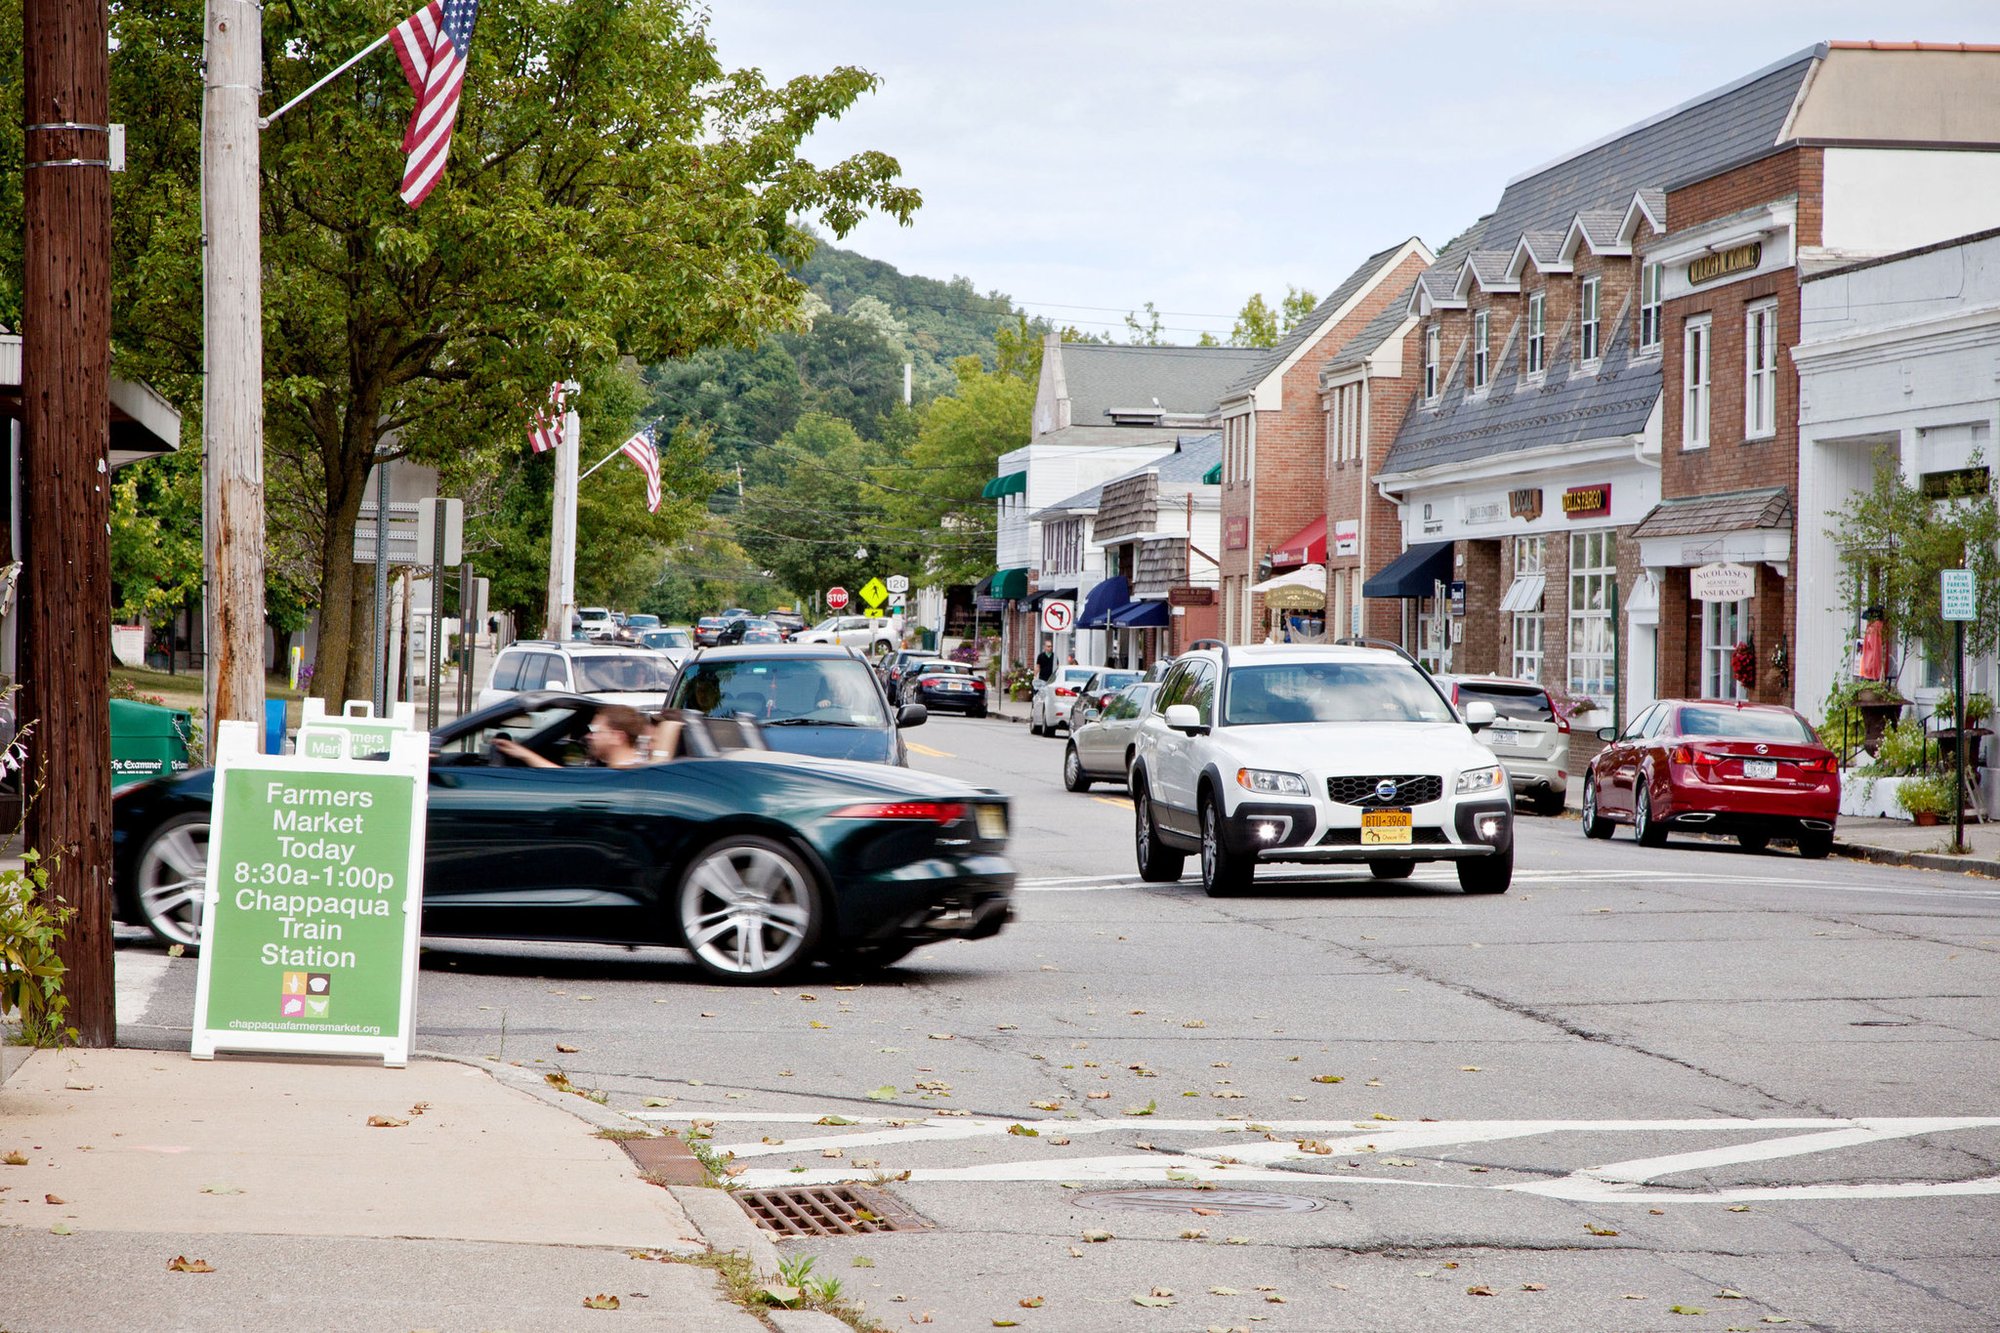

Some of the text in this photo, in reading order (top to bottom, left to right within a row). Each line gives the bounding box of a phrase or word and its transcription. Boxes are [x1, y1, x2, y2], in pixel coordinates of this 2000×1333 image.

[1562, 490, 1602, 513] WELLS FARGO
[888, 580, 906, 589] 120
[1697, 569, 1748, 580] NICOLAYSEN
[828, 594, 848, 602] STOP
[1701, 588, 1745, 597] INSURANCE
[124, 759, 162, 770] Examiner
[267, 782, 374, 808] Farmers
[273, 810, 364, 834] Market
[277, 836, 356, 865] Today
[234, 862, 395, 893] 8:30a-1:00p
[235, 888, 390, 918] Chappaqua
[278, 917, 342, 941] Train
[260, 943, 356, 968] Station
[229, 1019, 381, 1035] chappaquafarmersmarket.org
